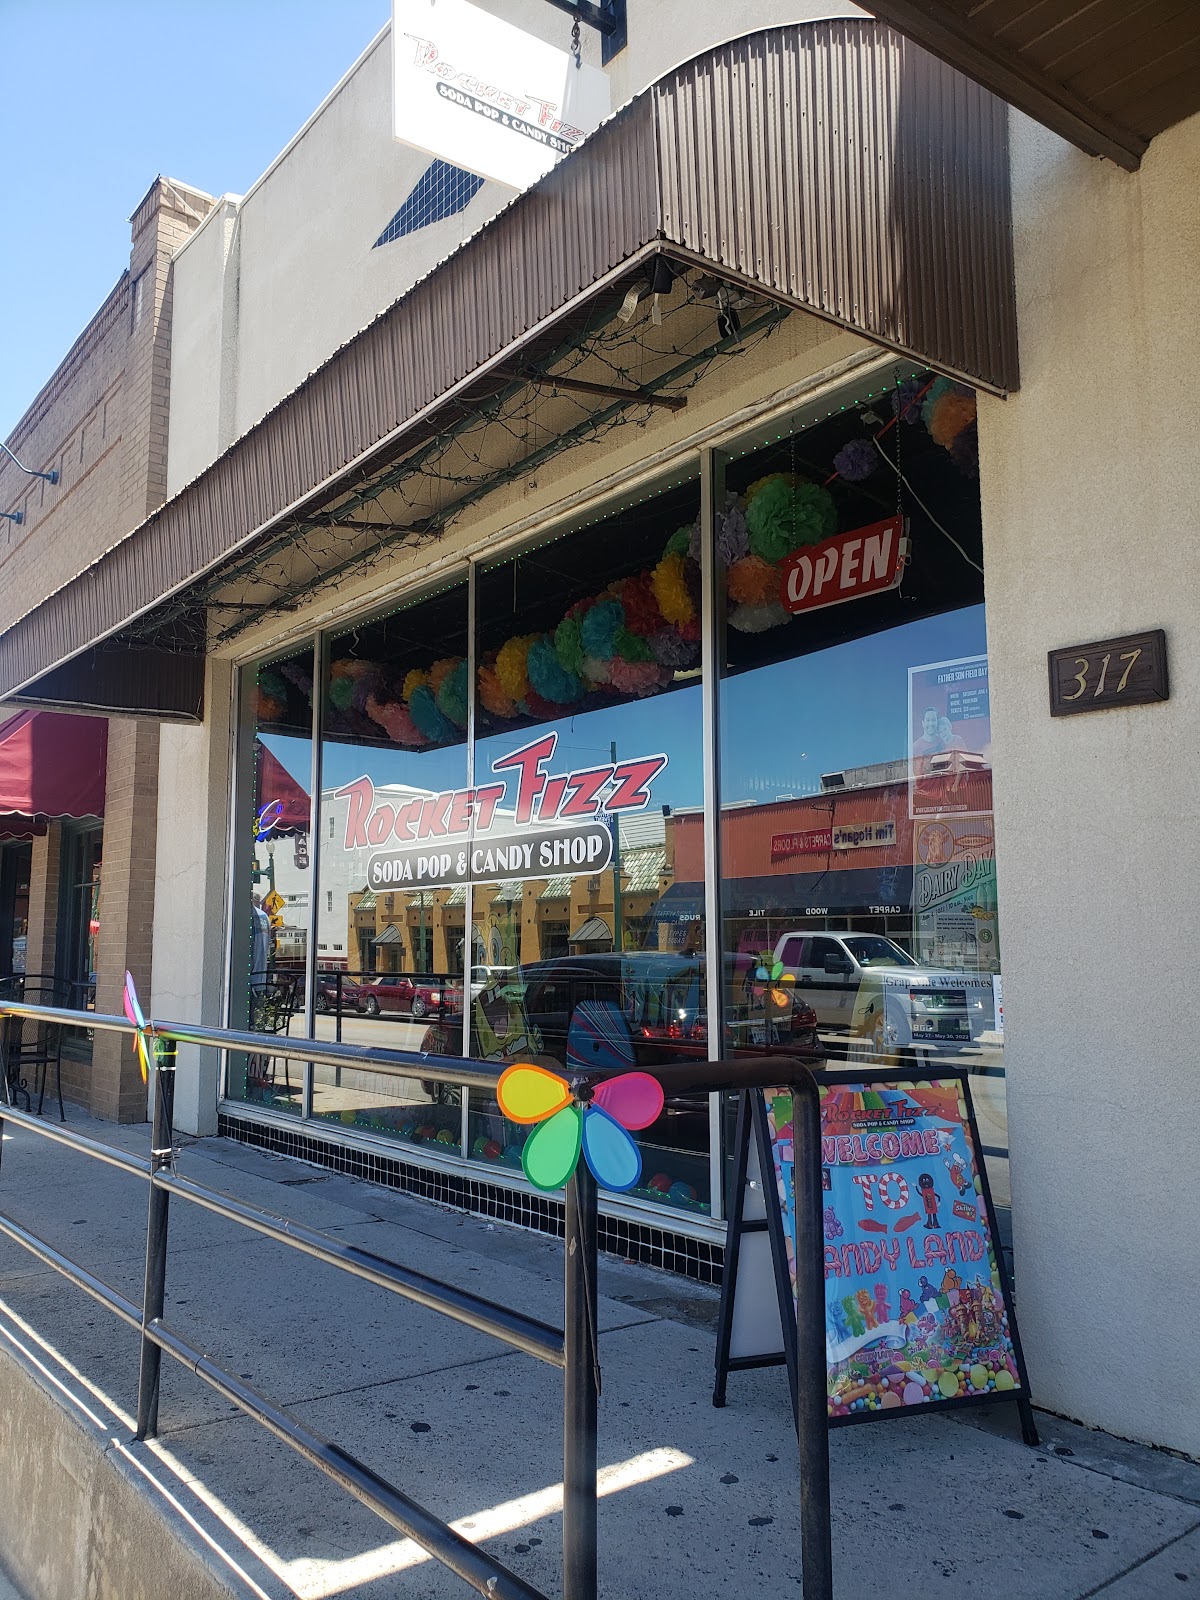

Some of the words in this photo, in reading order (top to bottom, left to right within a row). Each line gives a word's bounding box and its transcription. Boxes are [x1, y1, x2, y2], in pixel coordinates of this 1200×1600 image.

[403, 32, 531, 116] ROCKET
[525, 94, 588, 142] FIZ
[439, 85, 472, 110] SODA
[475, 97, 499, 121] POP
[501, 113, 510, 126] &
[511, 118, 548, 144] CANDY
[549, 135, 573, 154] SHO
[787, 528, 894, 603] OPEN
[937, 673, 955, 684] FATHER
[955, 671, 965, 681] SON
[965, 668, 978, 679] FIELD
[1062, 648, 1142, 700] 317
[334, 774, 507, 851] ROCKET
[491, 730, 669, 826] FIZZ
[373, 859, 412, 884] SODA
[417, 854, 452, 880] POP
[457, 851, 468, 876] &
[471, 842, 535, 875] CANDY
[539, 834, 603, 868] SHOP
[918, 864, 961, 908] DAIRY
[961, 849, 994, 888] DAY
[937, 976, 992, 989] Welcomes
[823, 1102, 893, 1123] ROCKET
[887, 1098, 940, 1118] FIZZ
[867, 1120, 878, 1128] POP
[852, 1171, 909, 1211] TO
[824, 1237, 900, 1279] ANDY
[906, 1230, 984, 1269] LAND
